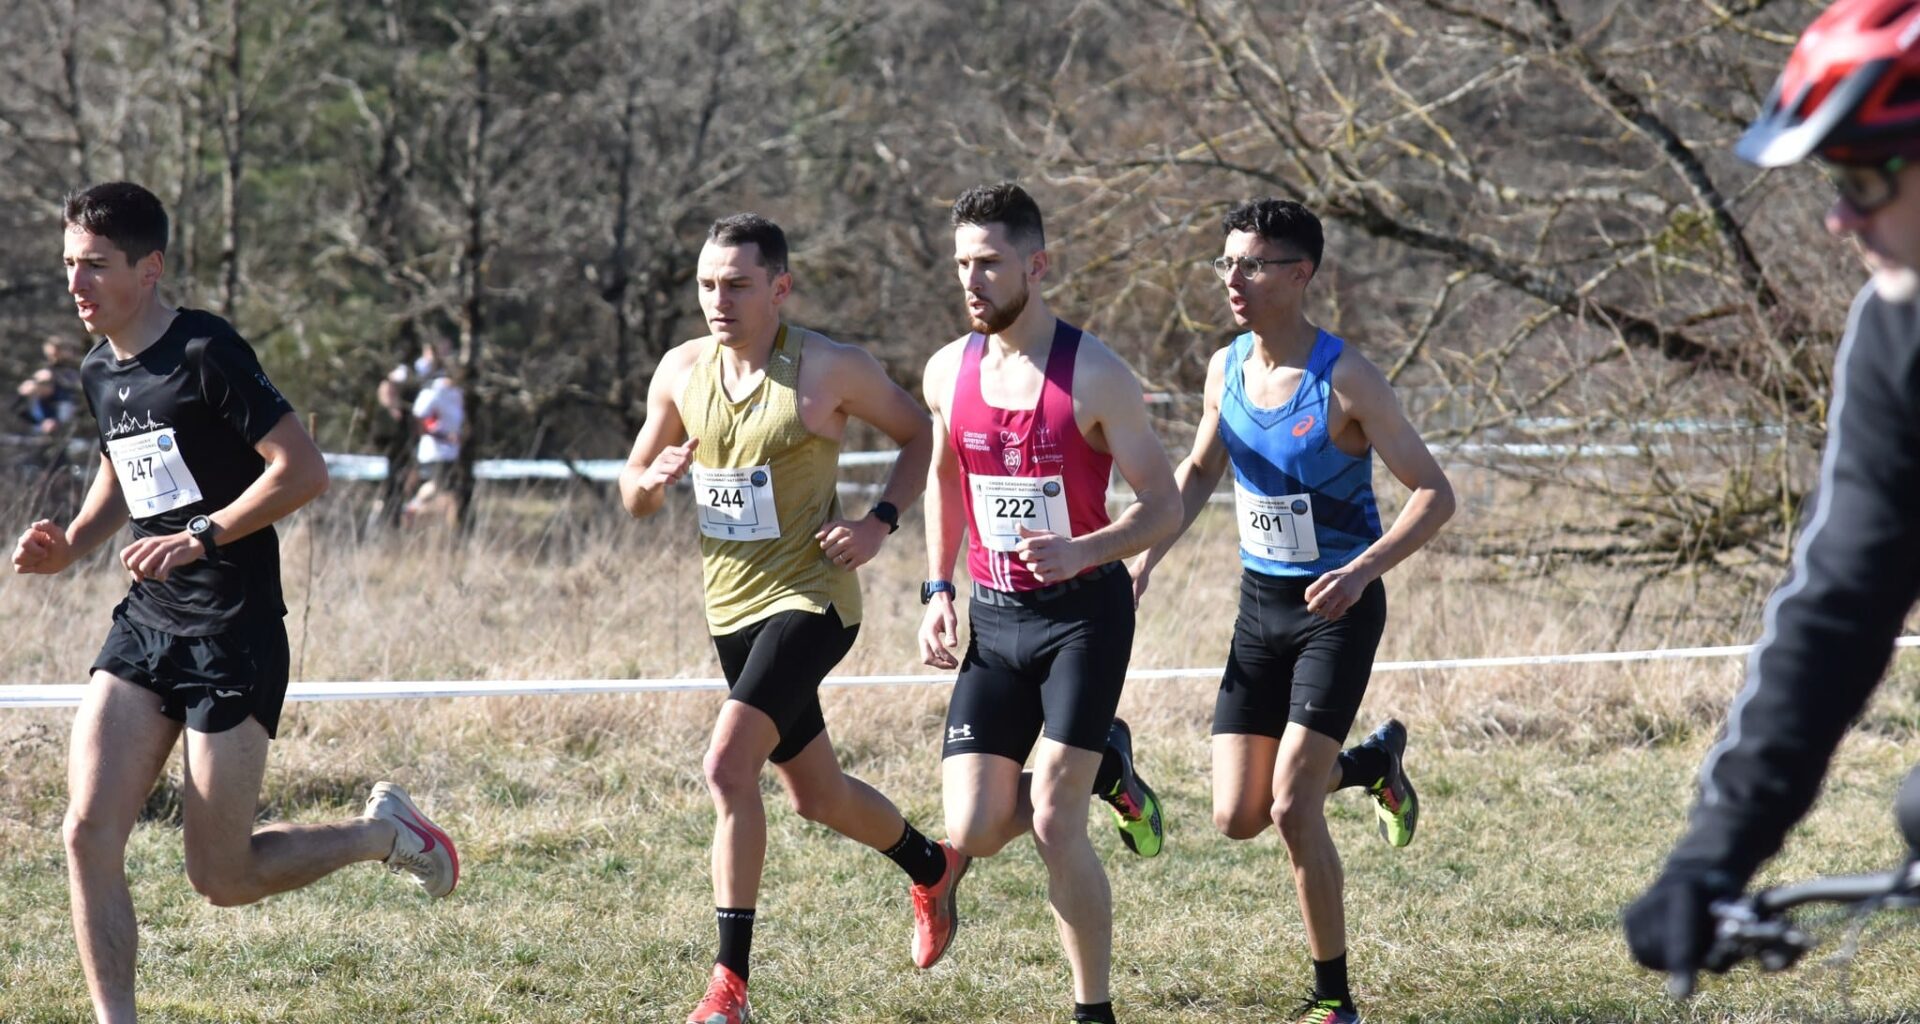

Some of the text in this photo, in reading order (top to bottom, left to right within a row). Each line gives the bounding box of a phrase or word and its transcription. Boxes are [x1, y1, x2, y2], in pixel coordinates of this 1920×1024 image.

[128, 456, 153, 482] 247
[708, 488, 745, 508] 244
[995, 498, 1036, 518] 222
[1250, 511, 1282, 533] 201
